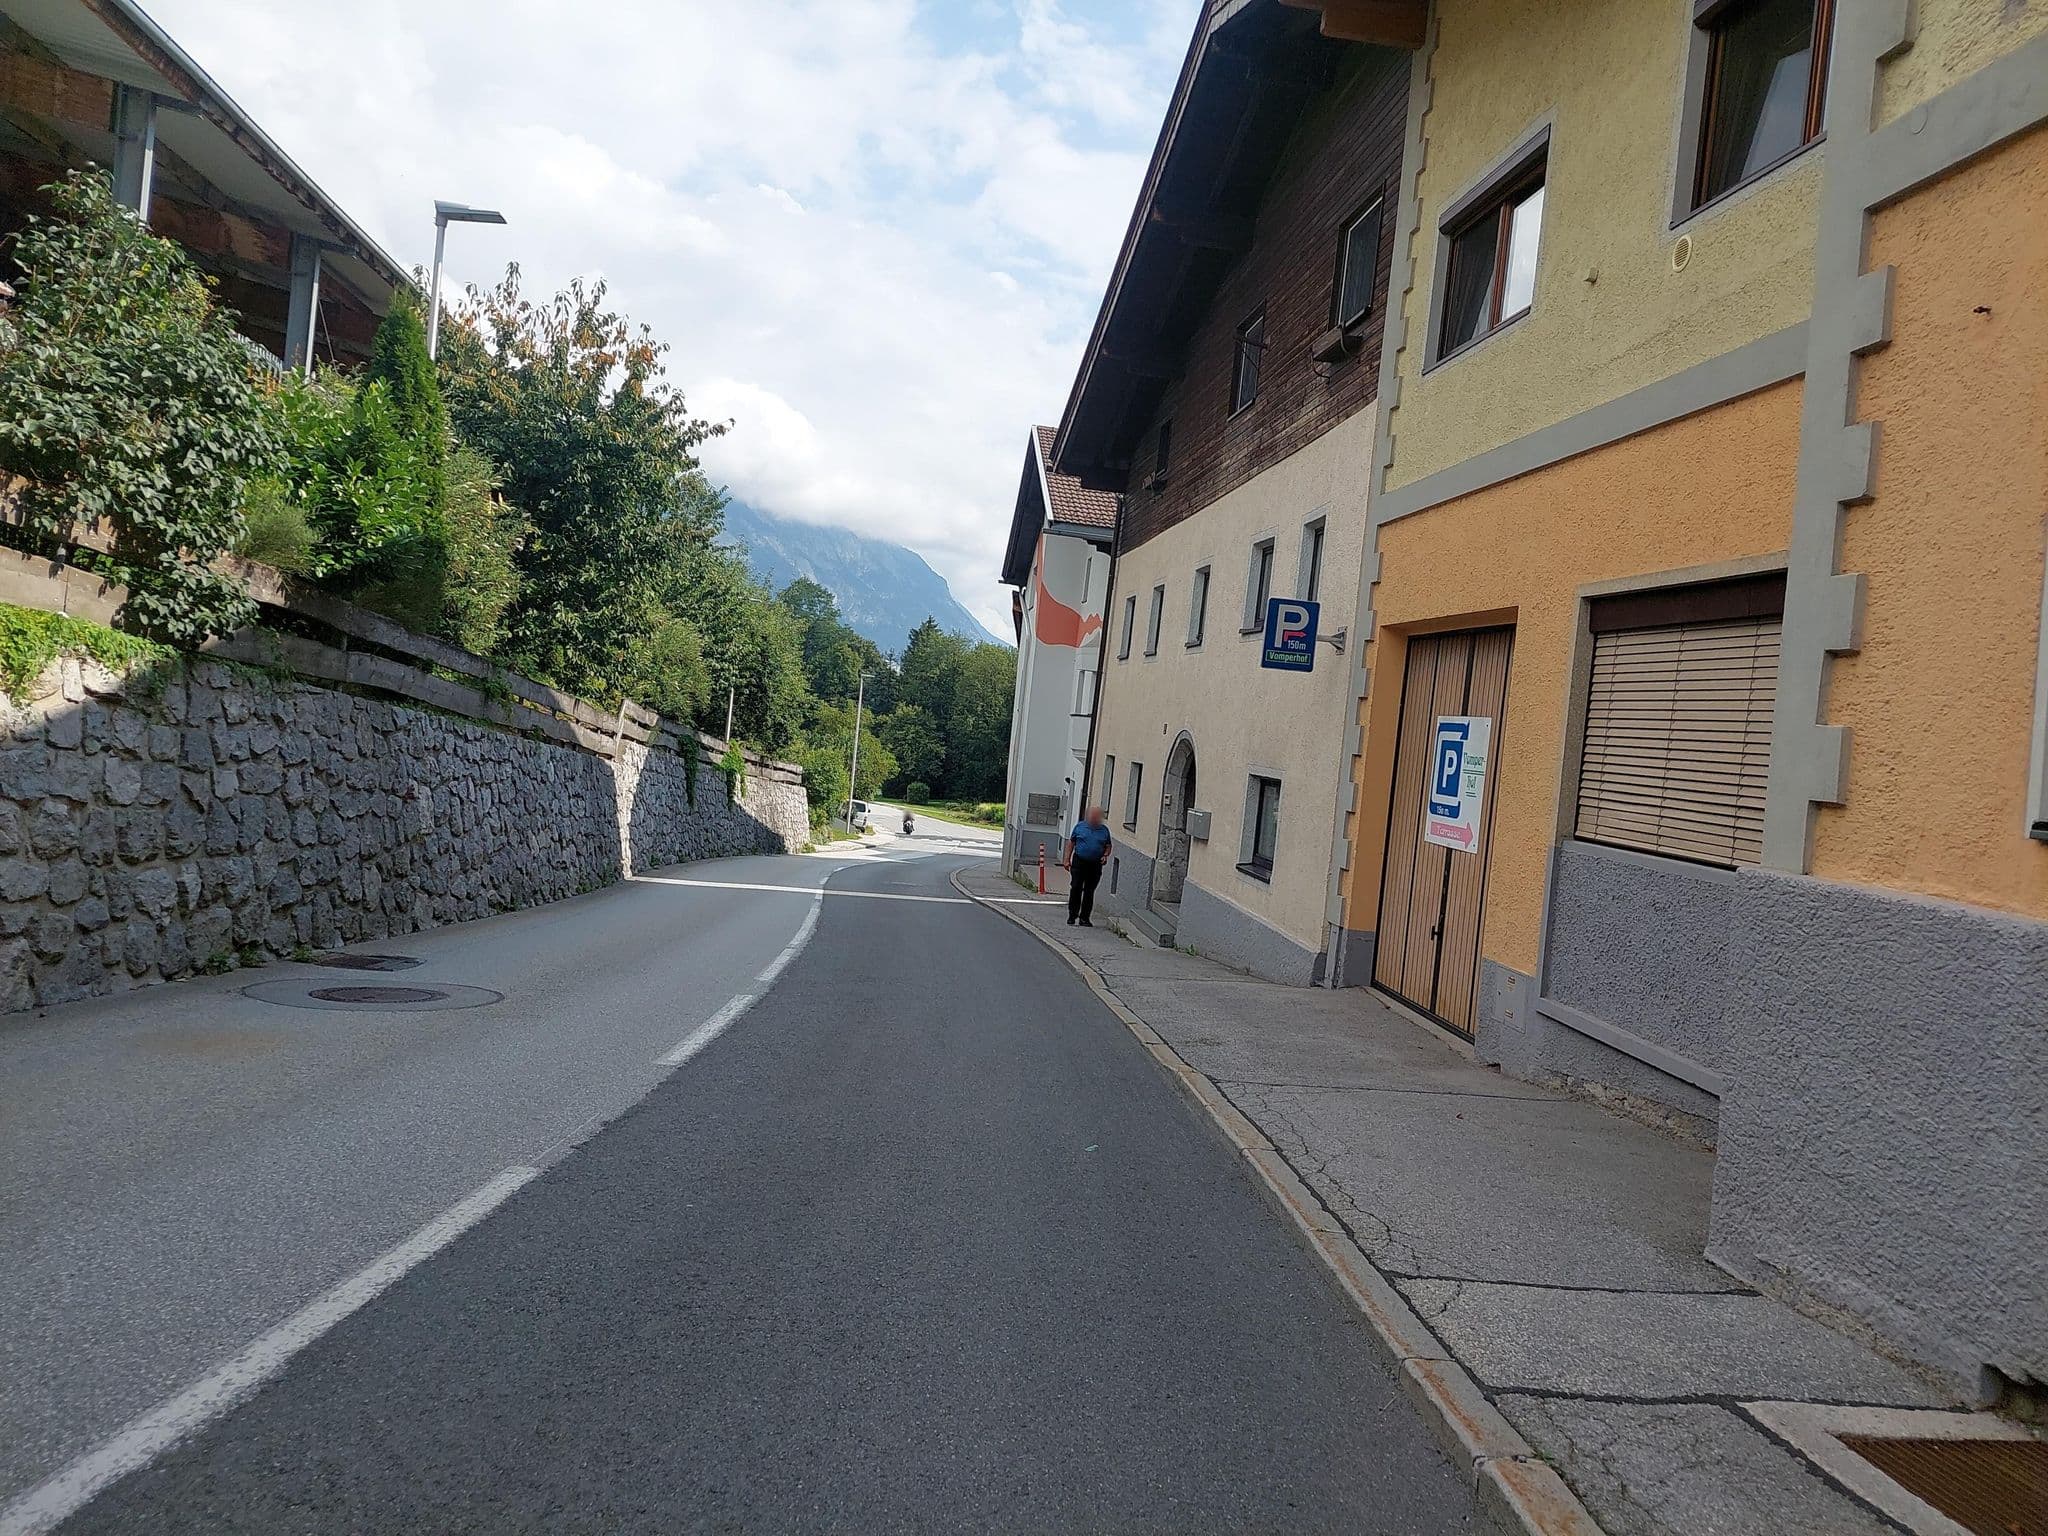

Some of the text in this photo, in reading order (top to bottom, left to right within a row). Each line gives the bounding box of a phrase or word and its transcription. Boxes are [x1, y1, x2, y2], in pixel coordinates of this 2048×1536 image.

[1275, 604, 1309, 648] P
[1287, 640, 1306, 650] 150m
[1270, 652, 1308, 663] Vomperhof
[1442, 750, 1457, 788] P
